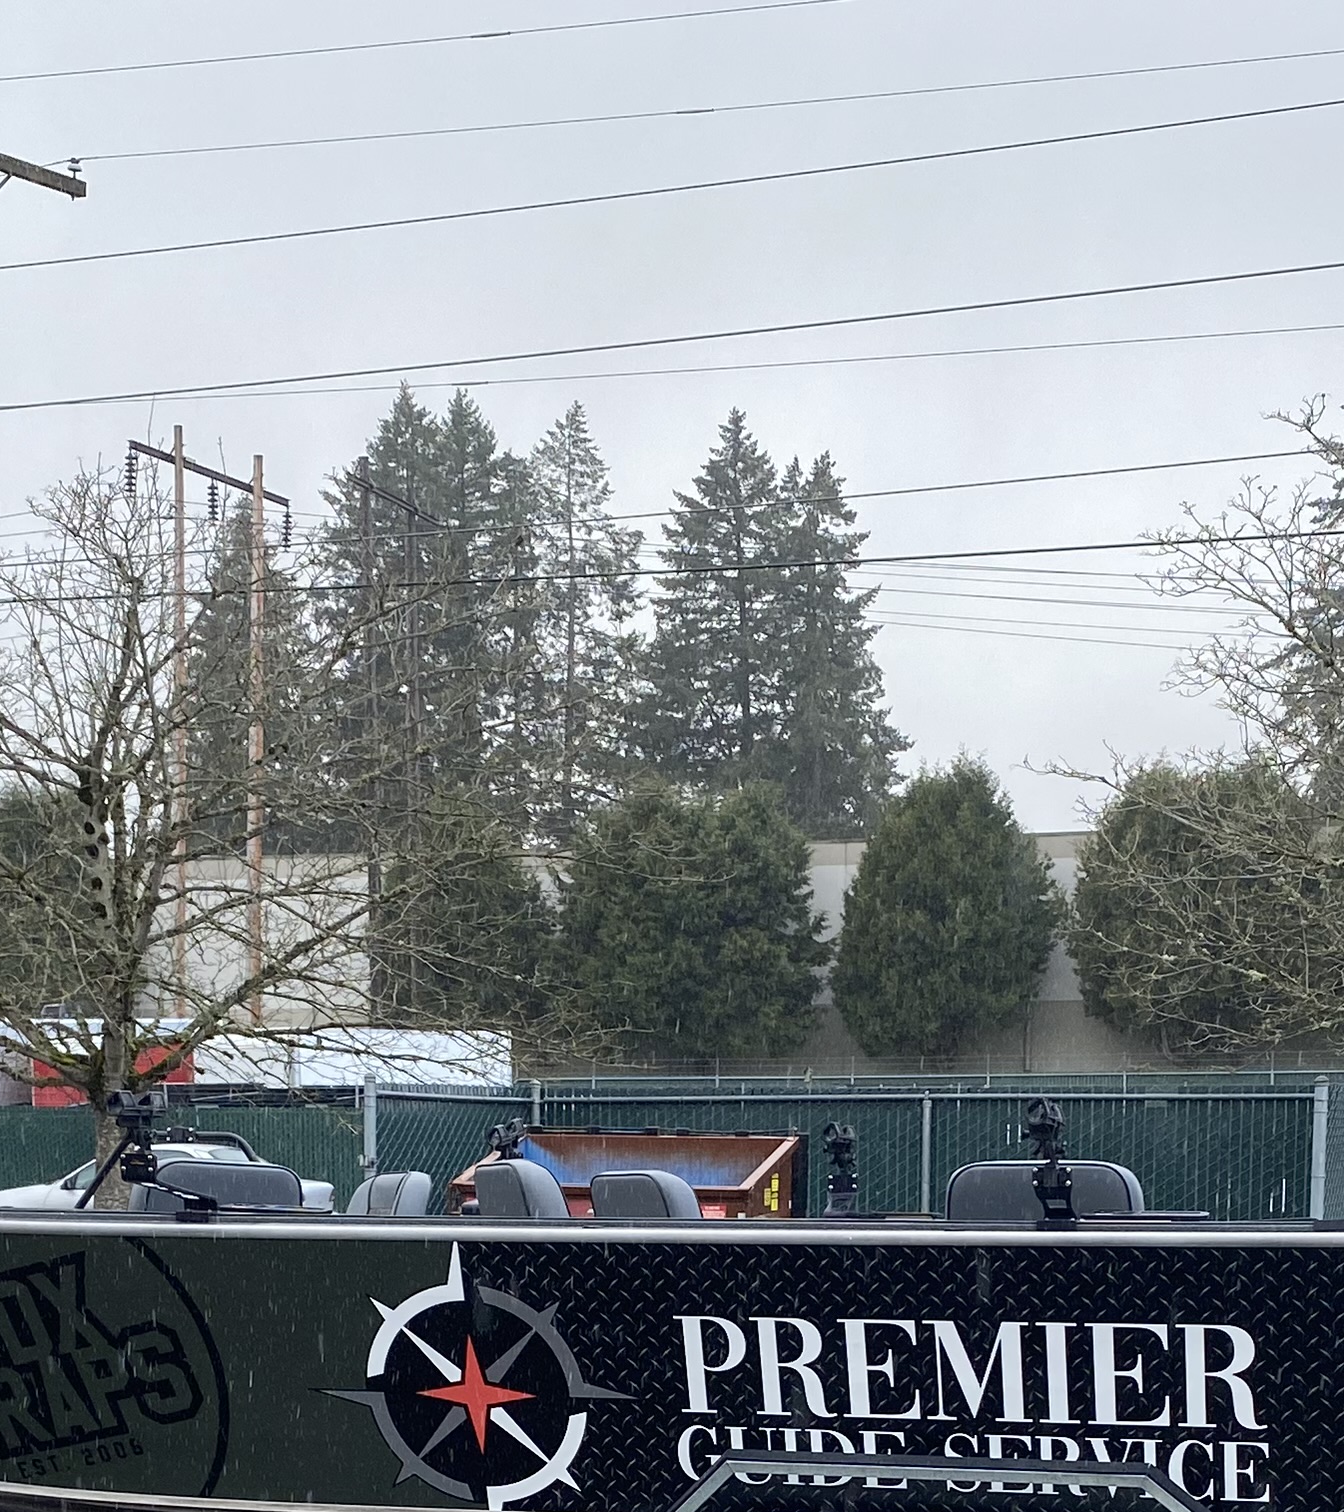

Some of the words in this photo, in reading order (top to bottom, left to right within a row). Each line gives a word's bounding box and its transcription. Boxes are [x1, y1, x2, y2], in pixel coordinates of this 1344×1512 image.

[672, 1315, 1269, 1431] PREMIER
[84, 1438, 145, 1467] 2006
[677, 1424, 908, 1490] GUIDE
[944, 1432, 1270, 1502] SERVICE
